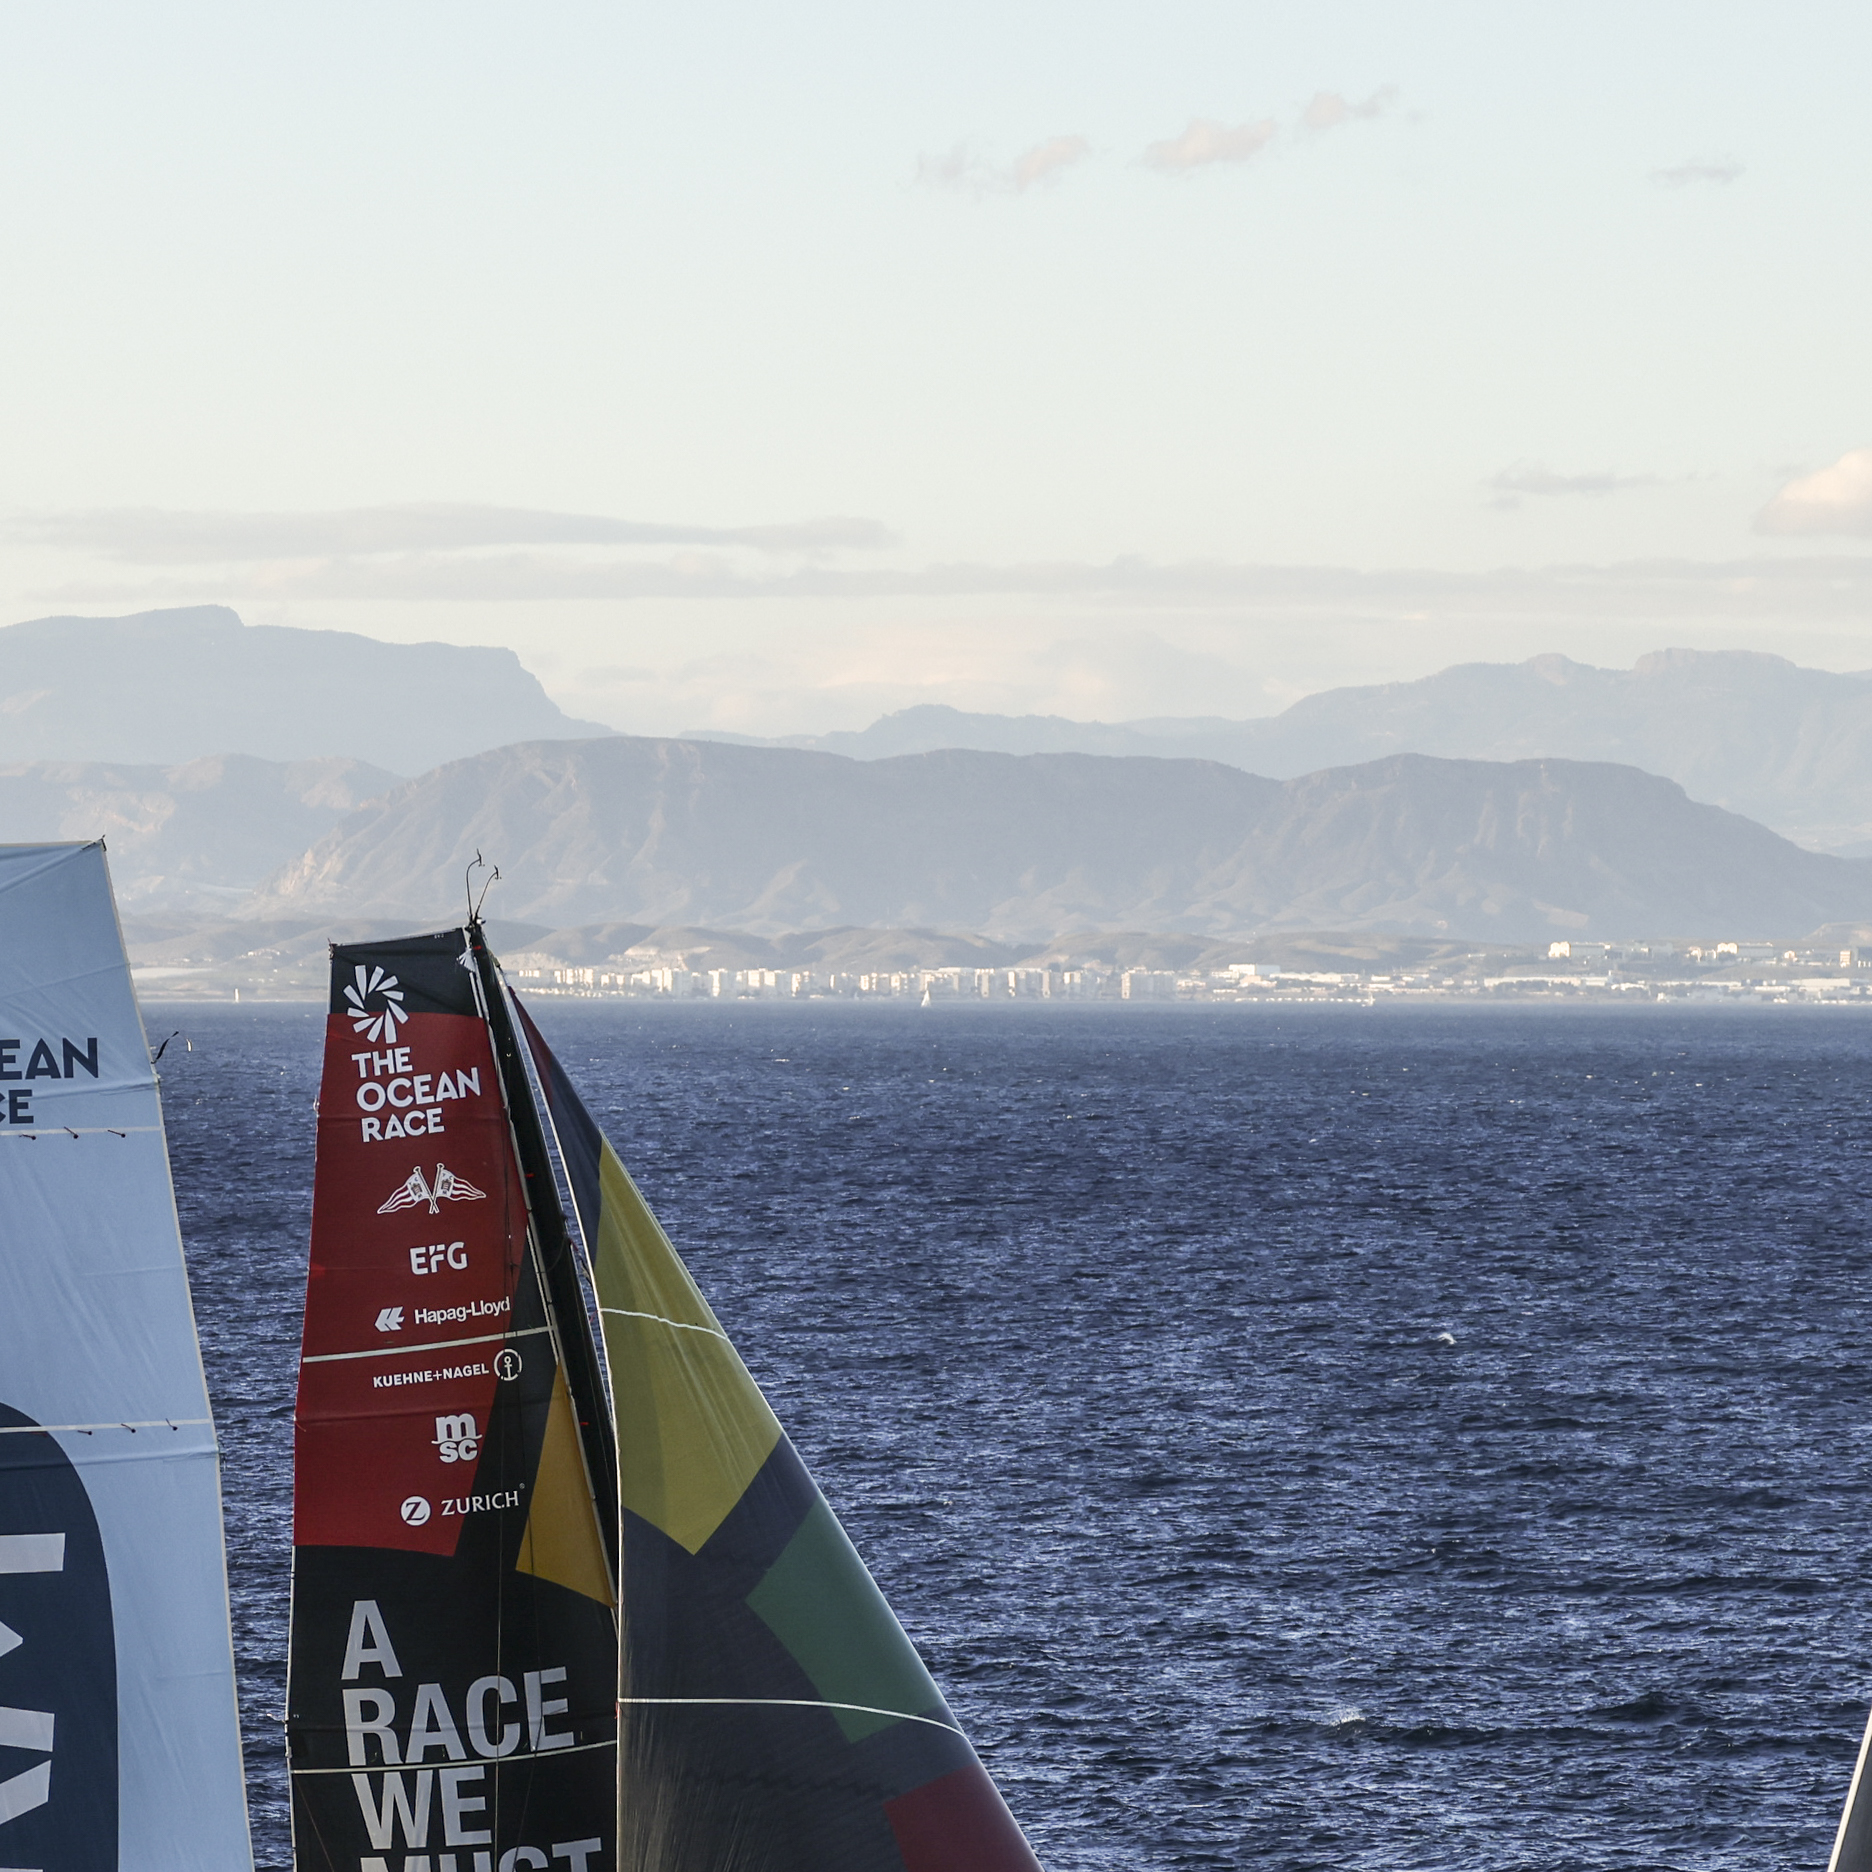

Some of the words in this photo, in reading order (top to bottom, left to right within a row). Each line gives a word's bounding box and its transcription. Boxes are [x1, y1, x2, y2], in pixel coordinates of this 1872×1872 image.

[352, 1047, 413, 1078] THE
[356, 1067, 481, 1112] OCEAN
[360, 1107, 445, 1143] RACE
[410, 1241, 468, 1276] EFG
[414, 1297, 511, 1327] Hapag-Lloyd
[373, 1363, 489, 1388] KUEHNE+NAGEL
[441, 1490, 520, 1516] ZURICH
[341, 1600, 403, 1680] A
[342, 1666, 575, 1766] RACE
[352, 1765, 492, 1850] WE
